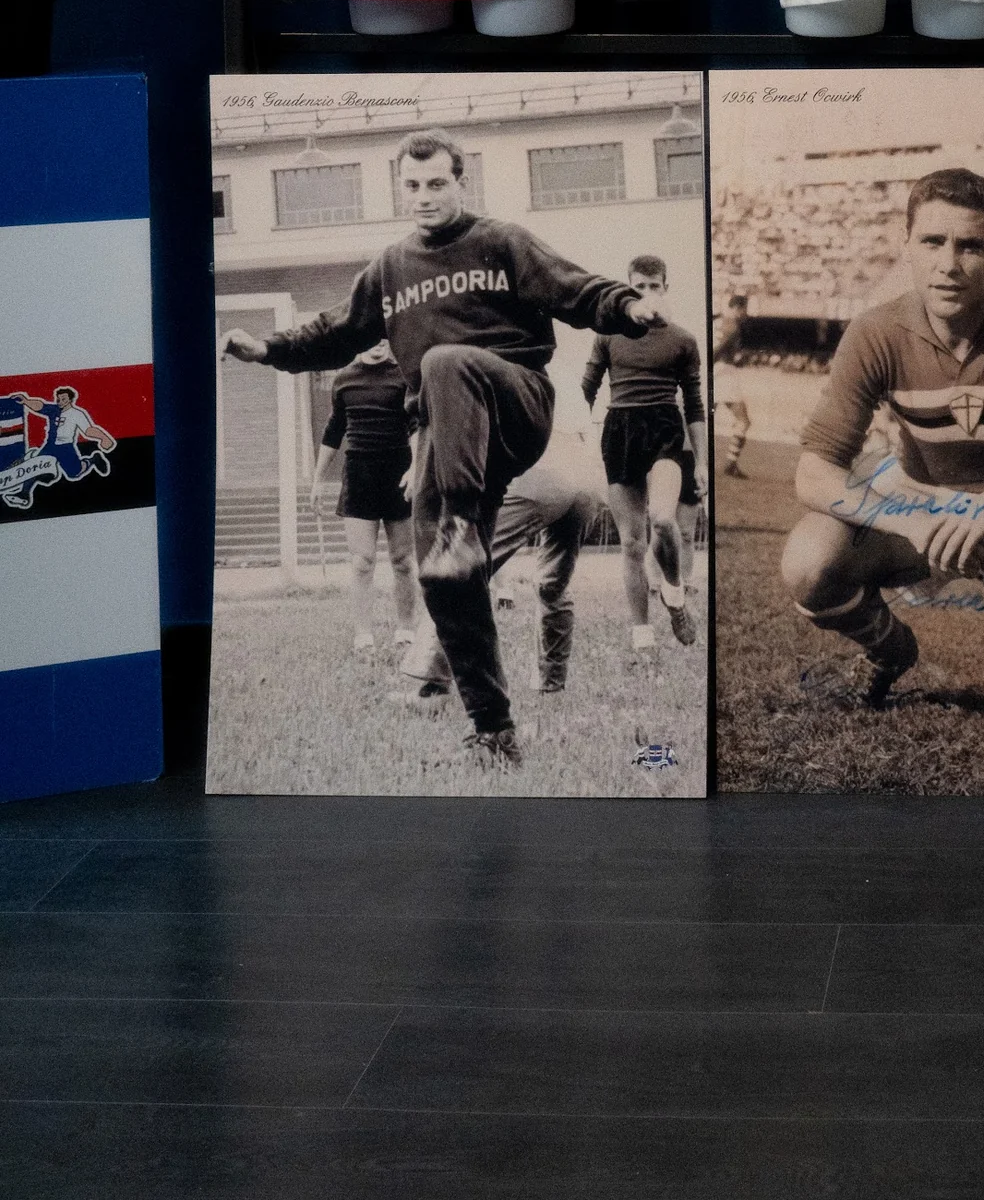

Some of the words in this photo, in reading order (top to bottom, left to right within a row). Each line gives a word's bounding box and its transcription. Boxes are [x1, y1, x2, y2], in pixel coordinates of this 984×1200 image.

[262, 90, 335, 108] Gaudenzio
[338, 90, 421, 108] Bernasconi
[762, 86, 809, 104] Ernest
[812, 86, 866, 104] Ocwirk
[381, 268, 511, 320] SAMPDORIA
